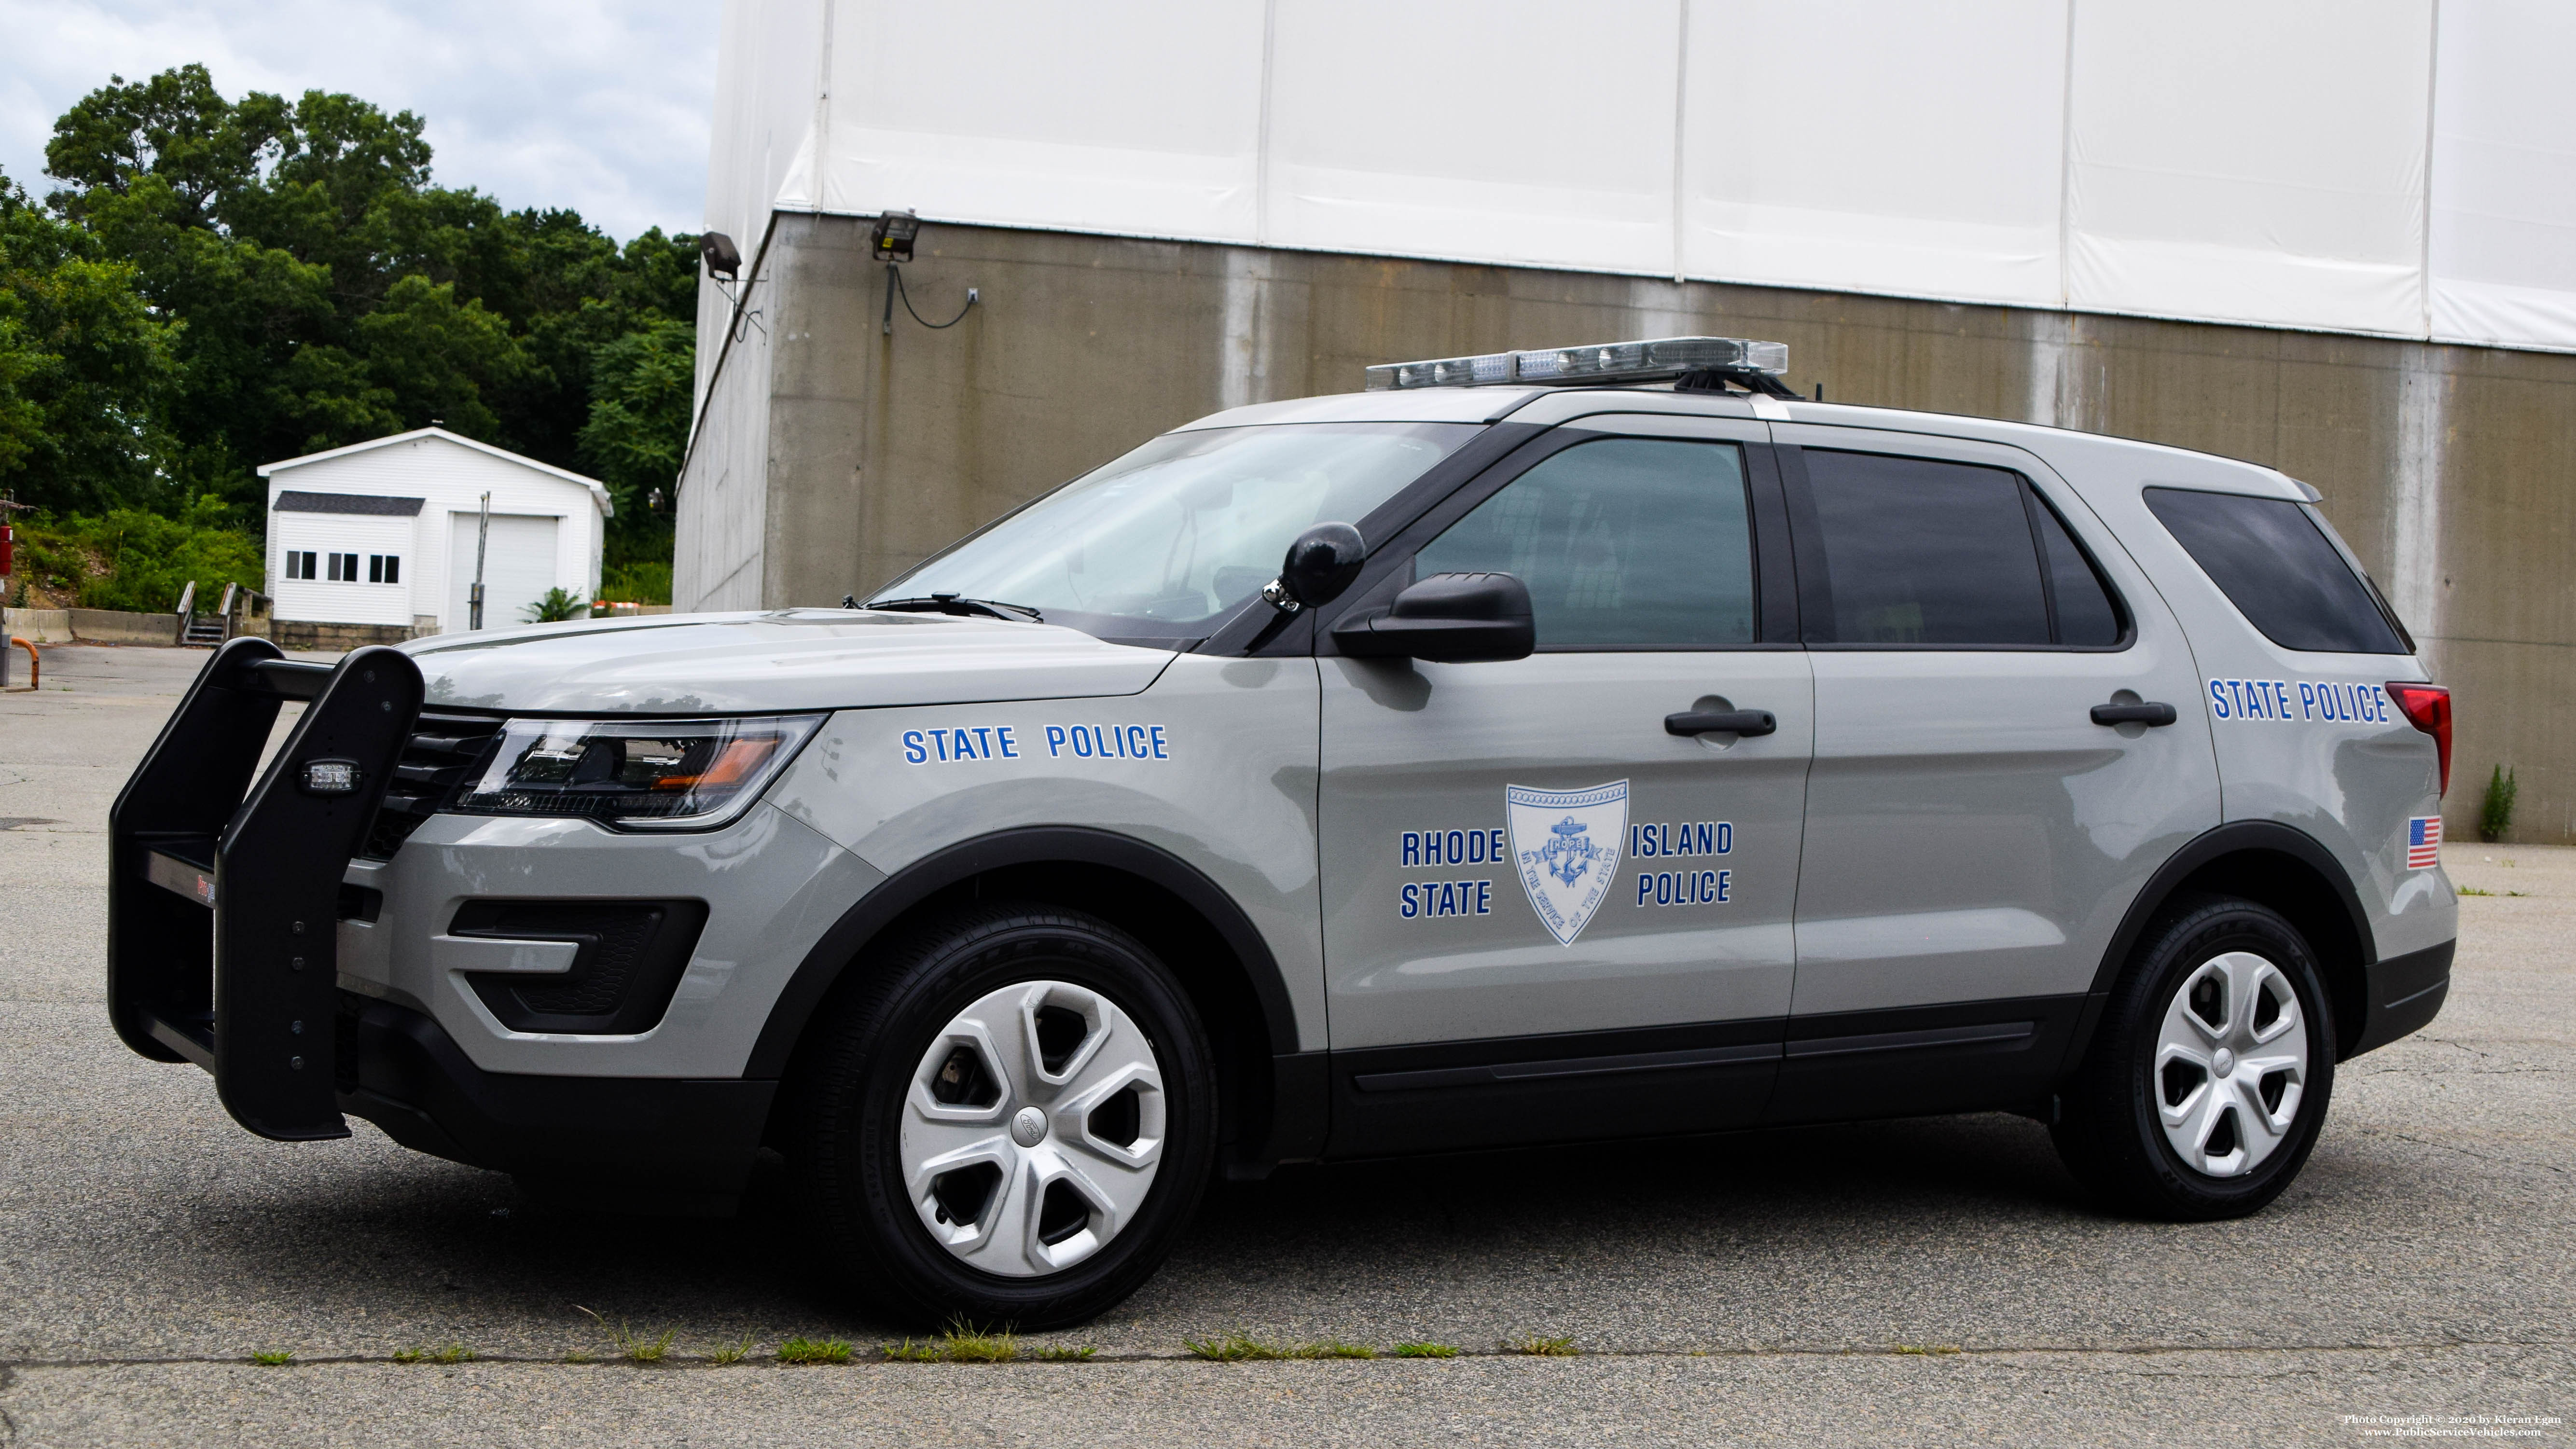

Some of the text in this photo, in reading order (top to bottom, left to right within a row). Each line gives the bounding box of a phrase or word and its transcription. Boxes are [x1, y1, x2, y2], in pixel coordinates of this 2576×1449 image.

[2208, 677, 2389, 724] STATE POLICE
[902, 724, 1170, 765] STATE POLICE
[1401, 822, 1733, 868] RHODE ISLAND
[1555, 839, 1582, 849] HOPE
[1400, 869, 1731, 919] STATE POLICE
[1521, 847, 1615, 929] IN THE SERVICE OF THE STATE
[1023, 1119, 1038, 1136] Ford
